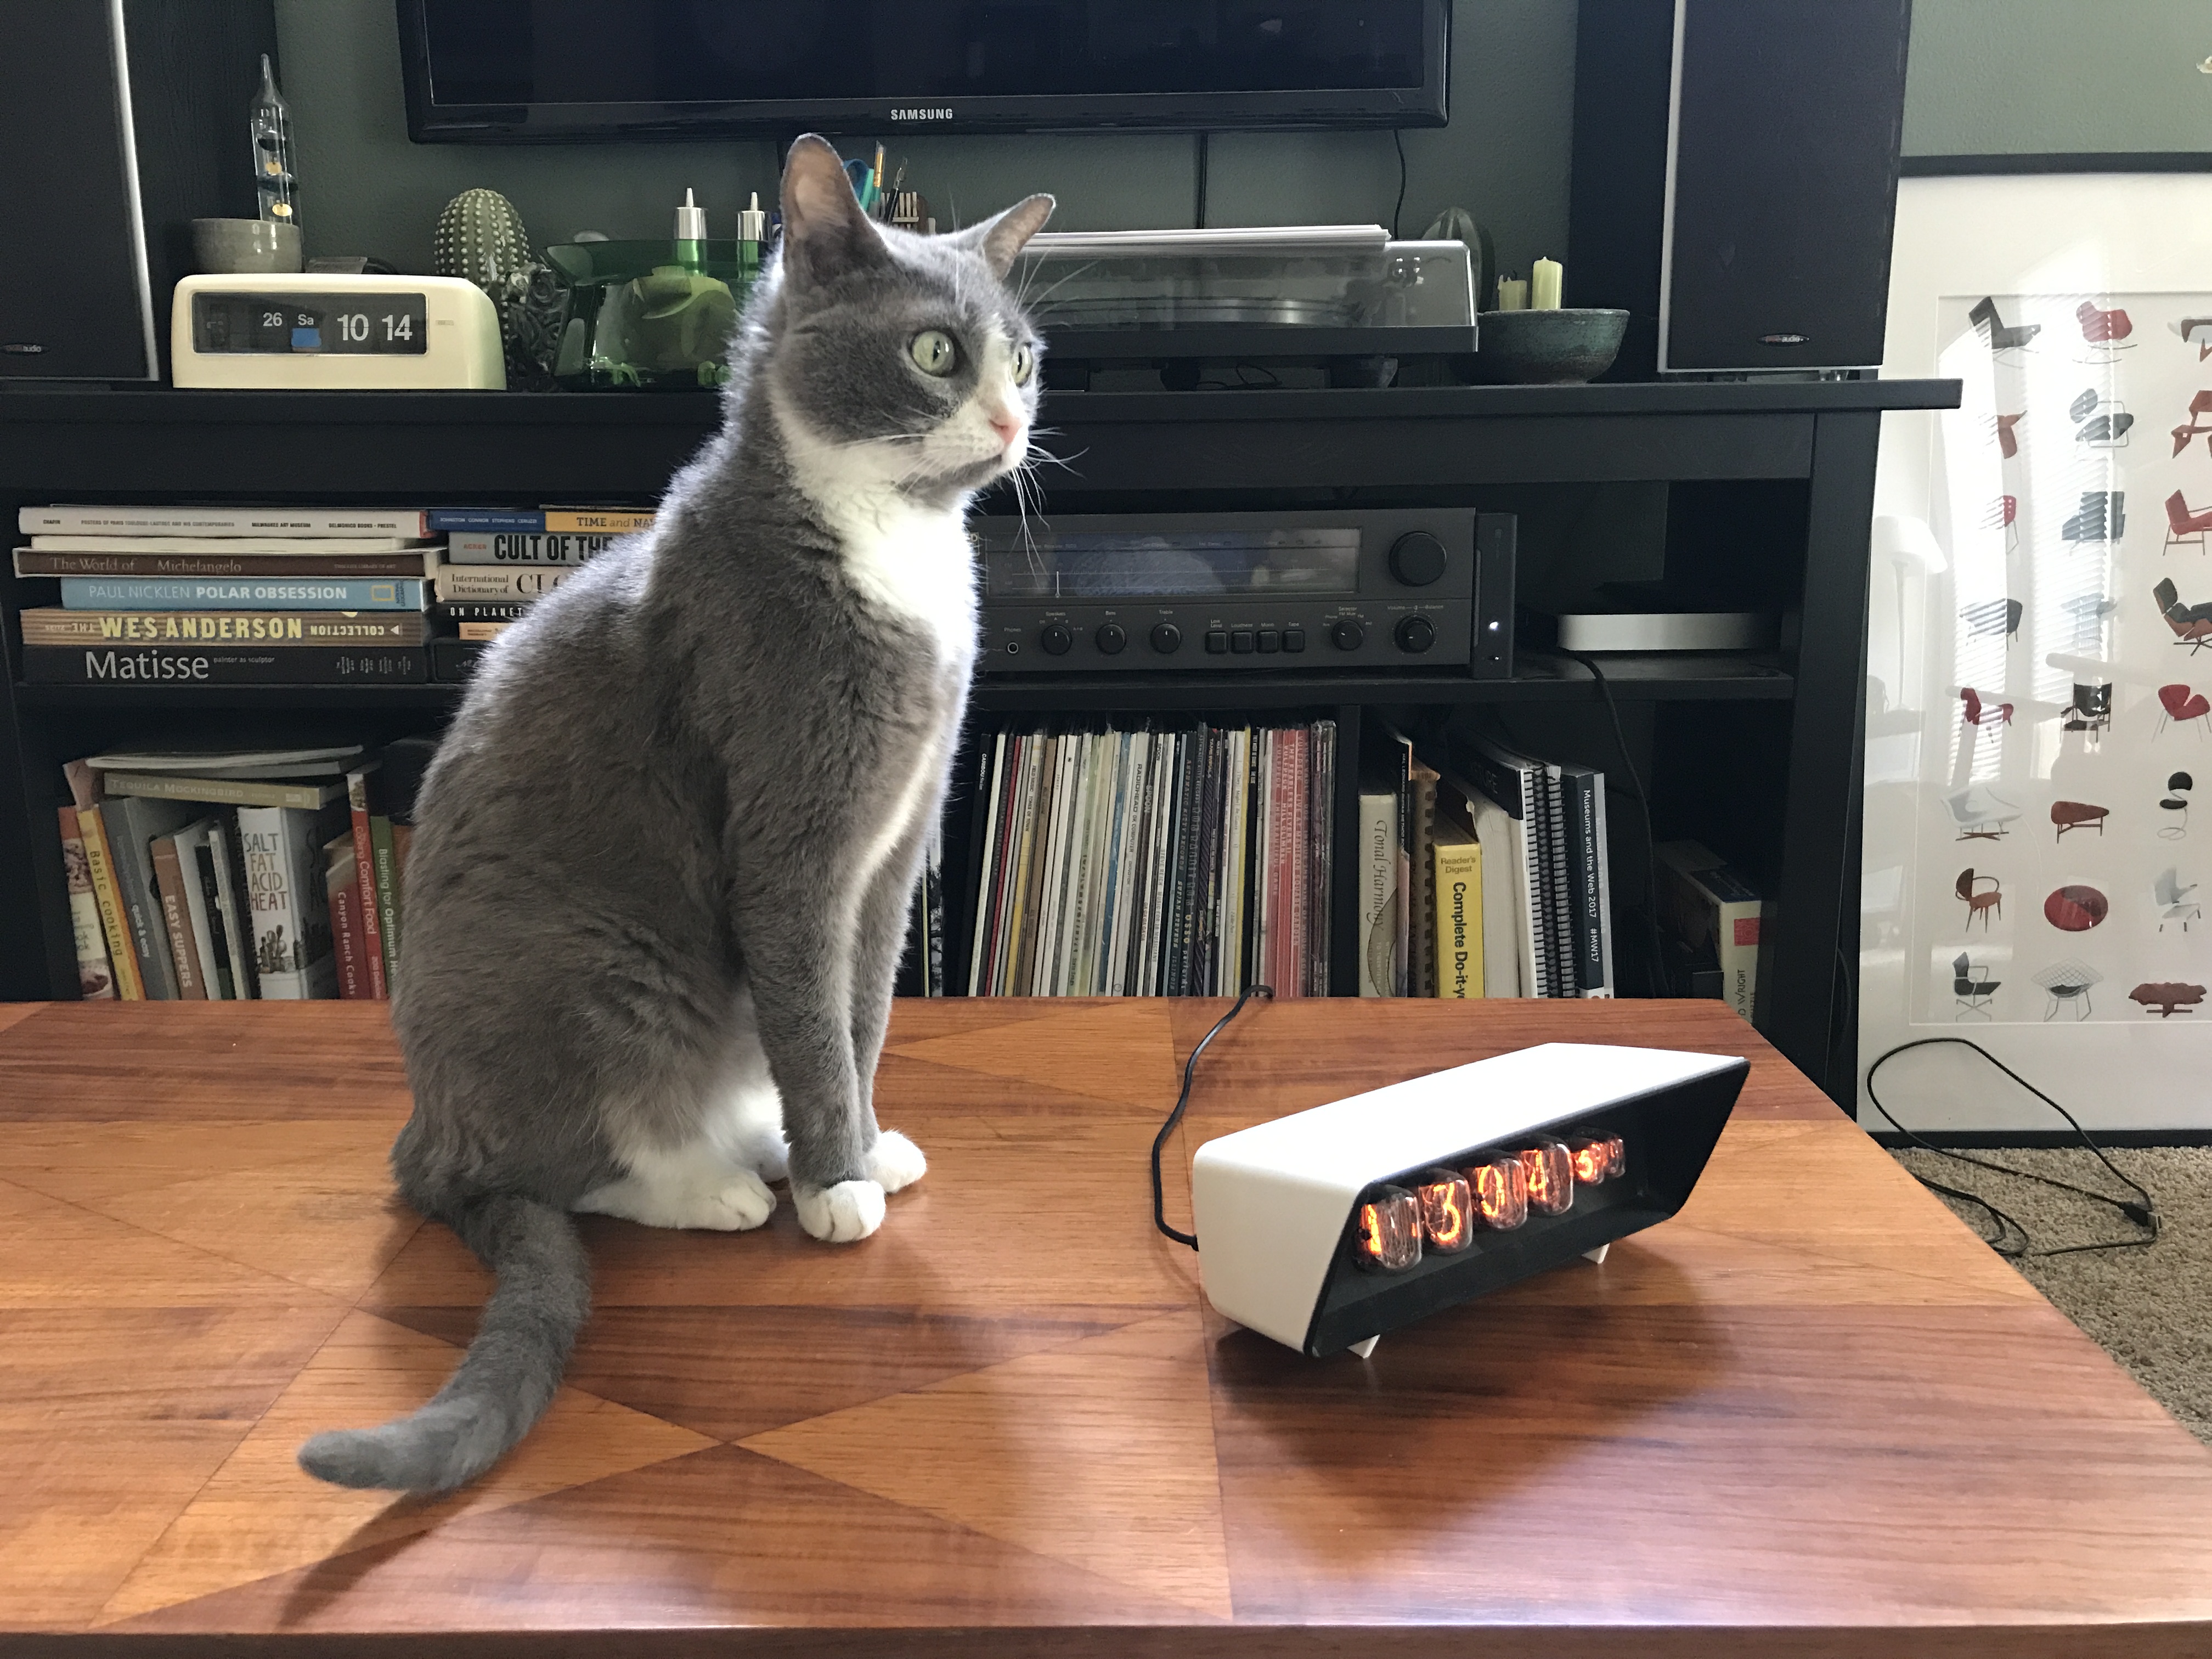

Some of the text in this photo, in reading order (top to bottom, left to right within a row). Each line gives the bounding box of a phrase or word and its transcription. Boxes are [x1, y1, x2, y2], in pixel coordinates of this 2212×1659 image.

[890, 108, 953, 120] SAMSUNG
[262, 312, 413, 341] 26 Sa 10 14
[577, 517, 630, 527] TIME and
[494, 534, 571, 561] CULT OF
[50, 557, 136, 570] The World of
[157, 558, 242, 573] Michelangelo
[452, 574, 509, 583] International
[89, 585, 190, 599] PAUL NICKLEN
[196, 586, 347, 600] POLAR OBSESSION
[453, 584, 509, 595] Dictionary of
[450, 607, 522, 617] ON PLANET
[71, 623, 95, 633] THE
[99, 617, 302, 639] WES ANDERSON
[311, 625, 385, 636] COLLECTION
[86, 649, 209, 679] Matisse
[248, 656, 275, 664] sculptor
[111, 779, 160, 791] TEQUILA
[164, 783, 244, 798] MOCKINGBIRD
[1133, 764, 1142, 812] RADIOHEAD
[1144, 785, 1153, 812] SPOON
[1583, 789, 1592, 834] Museums
[1296, 817, 1302, 828] AT
[243, 833, 279, 852] SALT
[250, 853, 276, 871] FAT
[1441, 856, 1476, 865] Reader's
[1444, 866, 1472, 874] Digest
[252, 872, 283, 891] ACID
[359, 861, 374, 906] Comfort
[1366, 820, 1391, 931] Tonal Harmony
[89, 850, 108, 890] Basic
[102, 900, 123, 956] cooking
[250, 891, 287, 911] HEAT
[378, 849, 396, 957] Blasting for Optimum
[1588, 896, 1596, 918] 2017
[365, 907, 377, 934] Food
[1302, 910, 1307, 919] OF
[1451, 882, 1467, 948] Complete
[131, 904, 144, 928] quick
[140, 938, 150, 958] easy
[1183, 914, 1192, 944] OSSO
[165, 895, 193, 988] EASY SUPPERS
[338, 891, 357, 995] Canyon Ranch Cooks
[1590, 928, 1599, 962] #MW17
[1735, 969, 1746, 1005] WRIGHT
